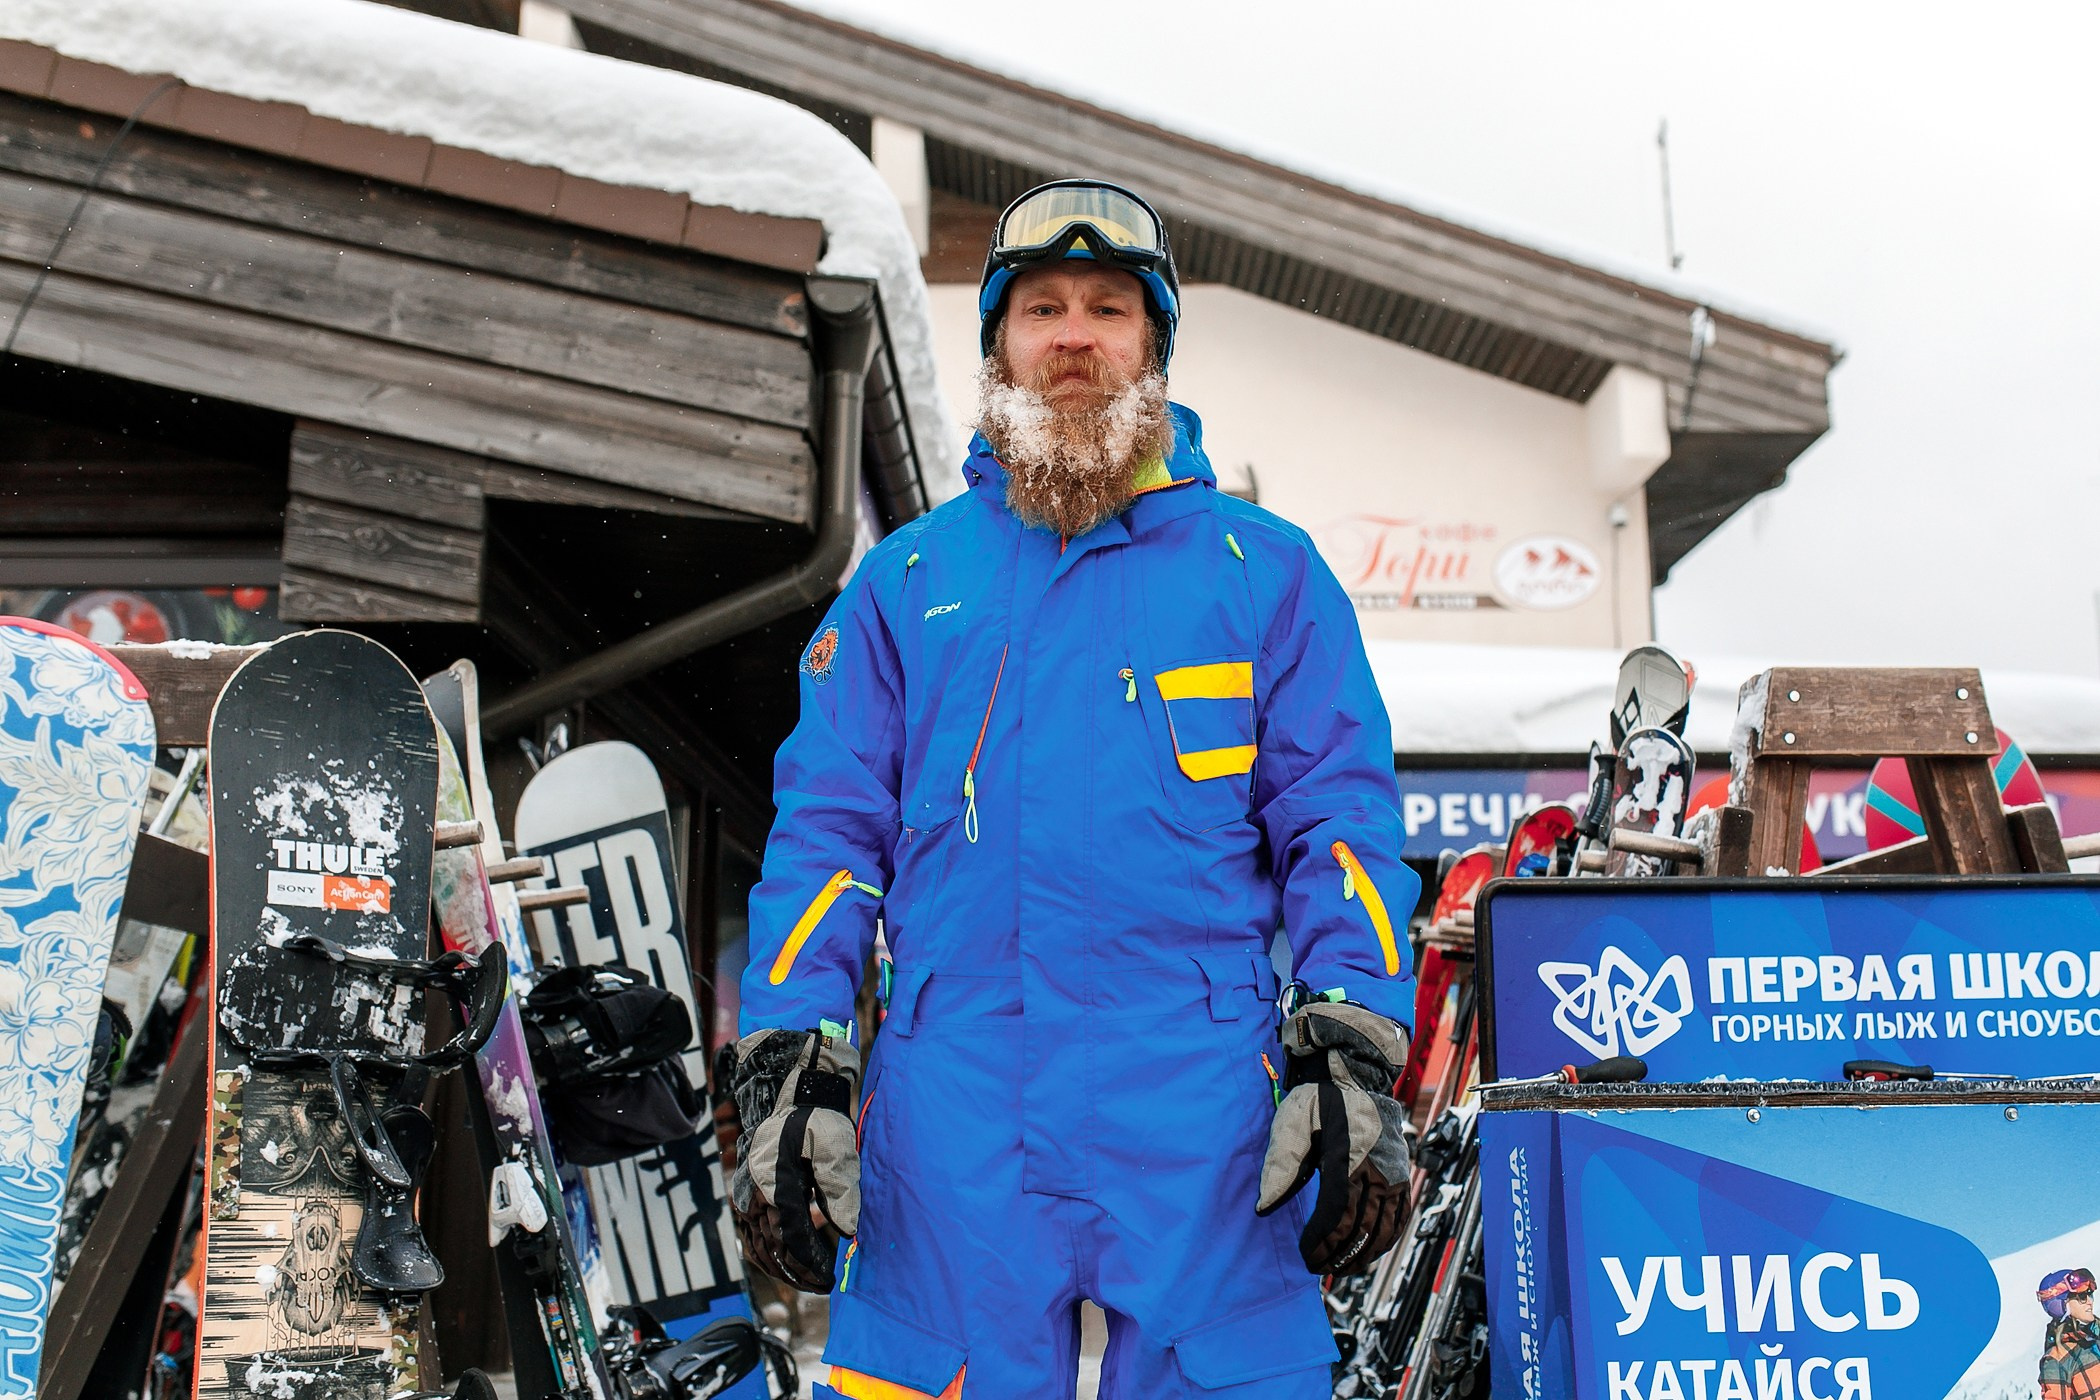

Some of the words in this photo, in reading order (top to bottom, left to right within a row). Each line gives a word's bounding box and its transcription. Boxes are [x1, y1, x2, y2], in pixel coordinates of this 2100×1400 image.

[1402, 793, 1543, 836] РЕЧИ
[272, 839, 385, 873] THULE
[353, 865, 383, 874] SWEDEN
[276, 884, 316, 894] SONY
[1707, 954, 1937, 1004] ПЕРВАЯ
[1711, 1013, 1845, 1043] ГОРНЫХ
[1853, 1011, 1938, 1041] ЛЫЖ
[1945, 1011, 1967, 1039] И
[1509, 1147, 1530, 1319] ШКОЛА
[1519, 1147, 1537, 1304] СНОУБОРДА
[1600, 1252, 1920, 1336] УЧИСЬ
[1521, 1331, 1535, 1400] АЯ
[1607, 1343, 1873, 1400] КАТАЙСЯ
